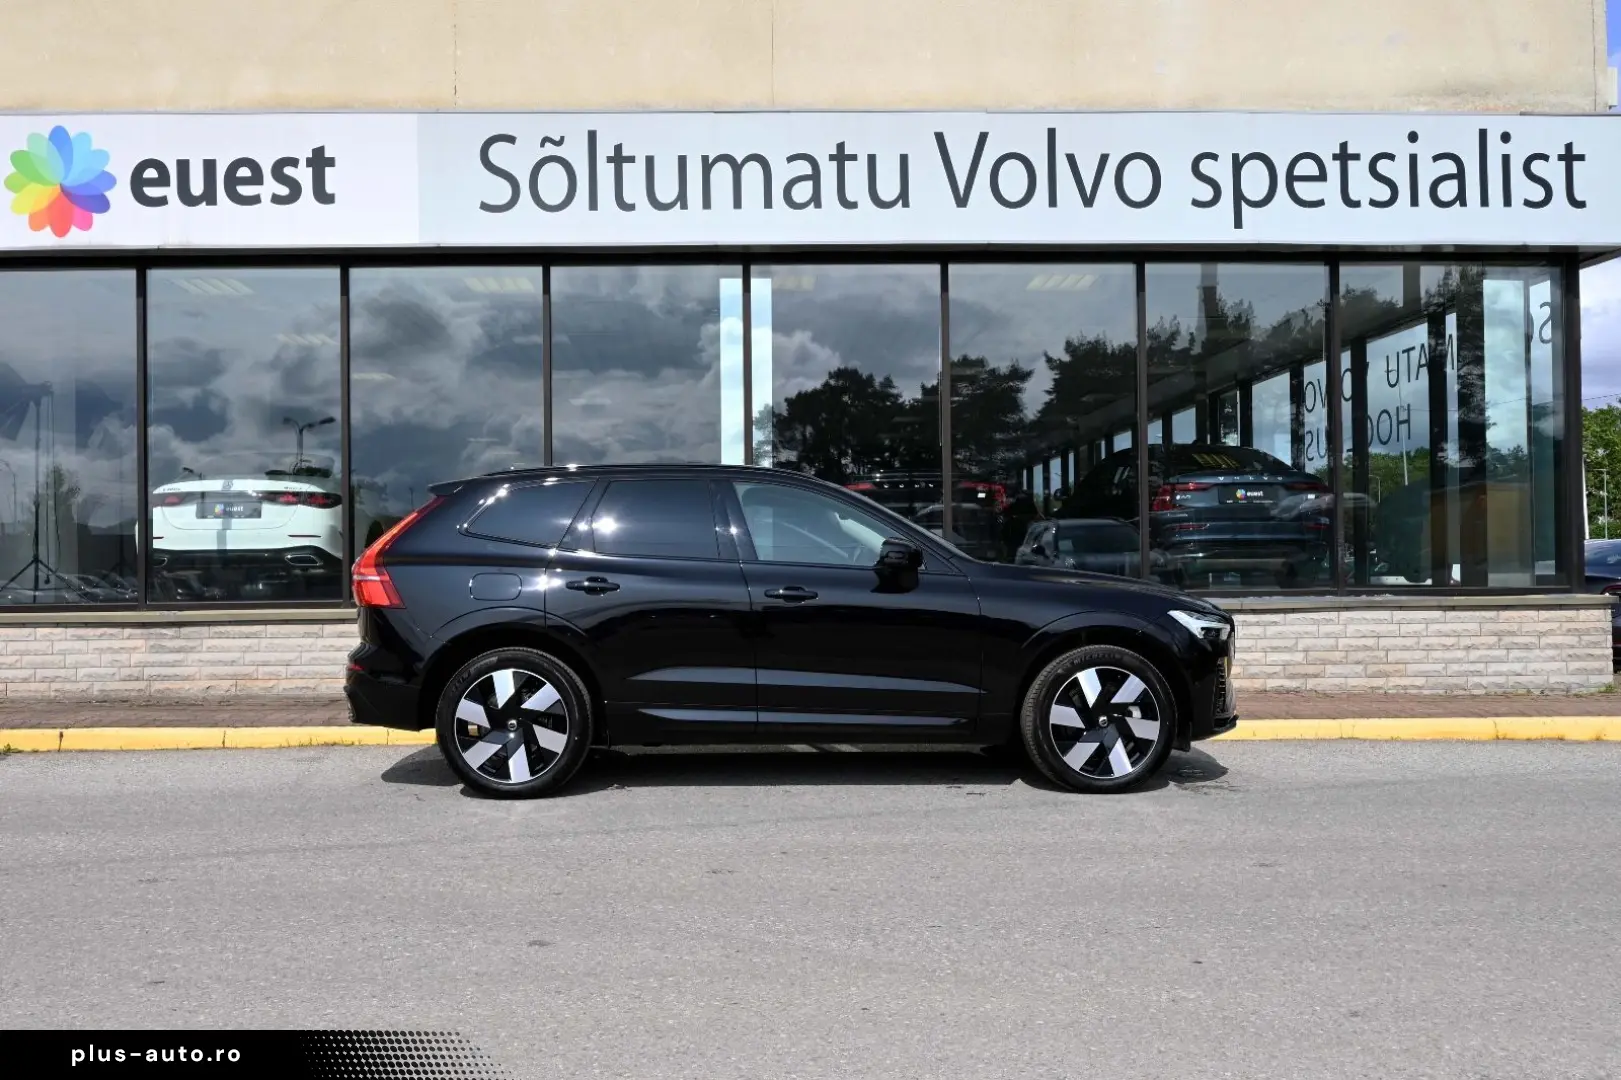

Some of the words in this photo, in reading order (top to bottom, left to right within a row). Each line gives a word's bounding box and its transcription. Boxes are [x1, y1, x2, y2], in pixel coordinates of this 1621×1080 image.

[130, 145, 336, 207] euest
[479, 130, 910, 213] Sõltumatu
[934, 128, 1162, 209] Volvo
[1190, 128, 1587, 229] spetsialist
